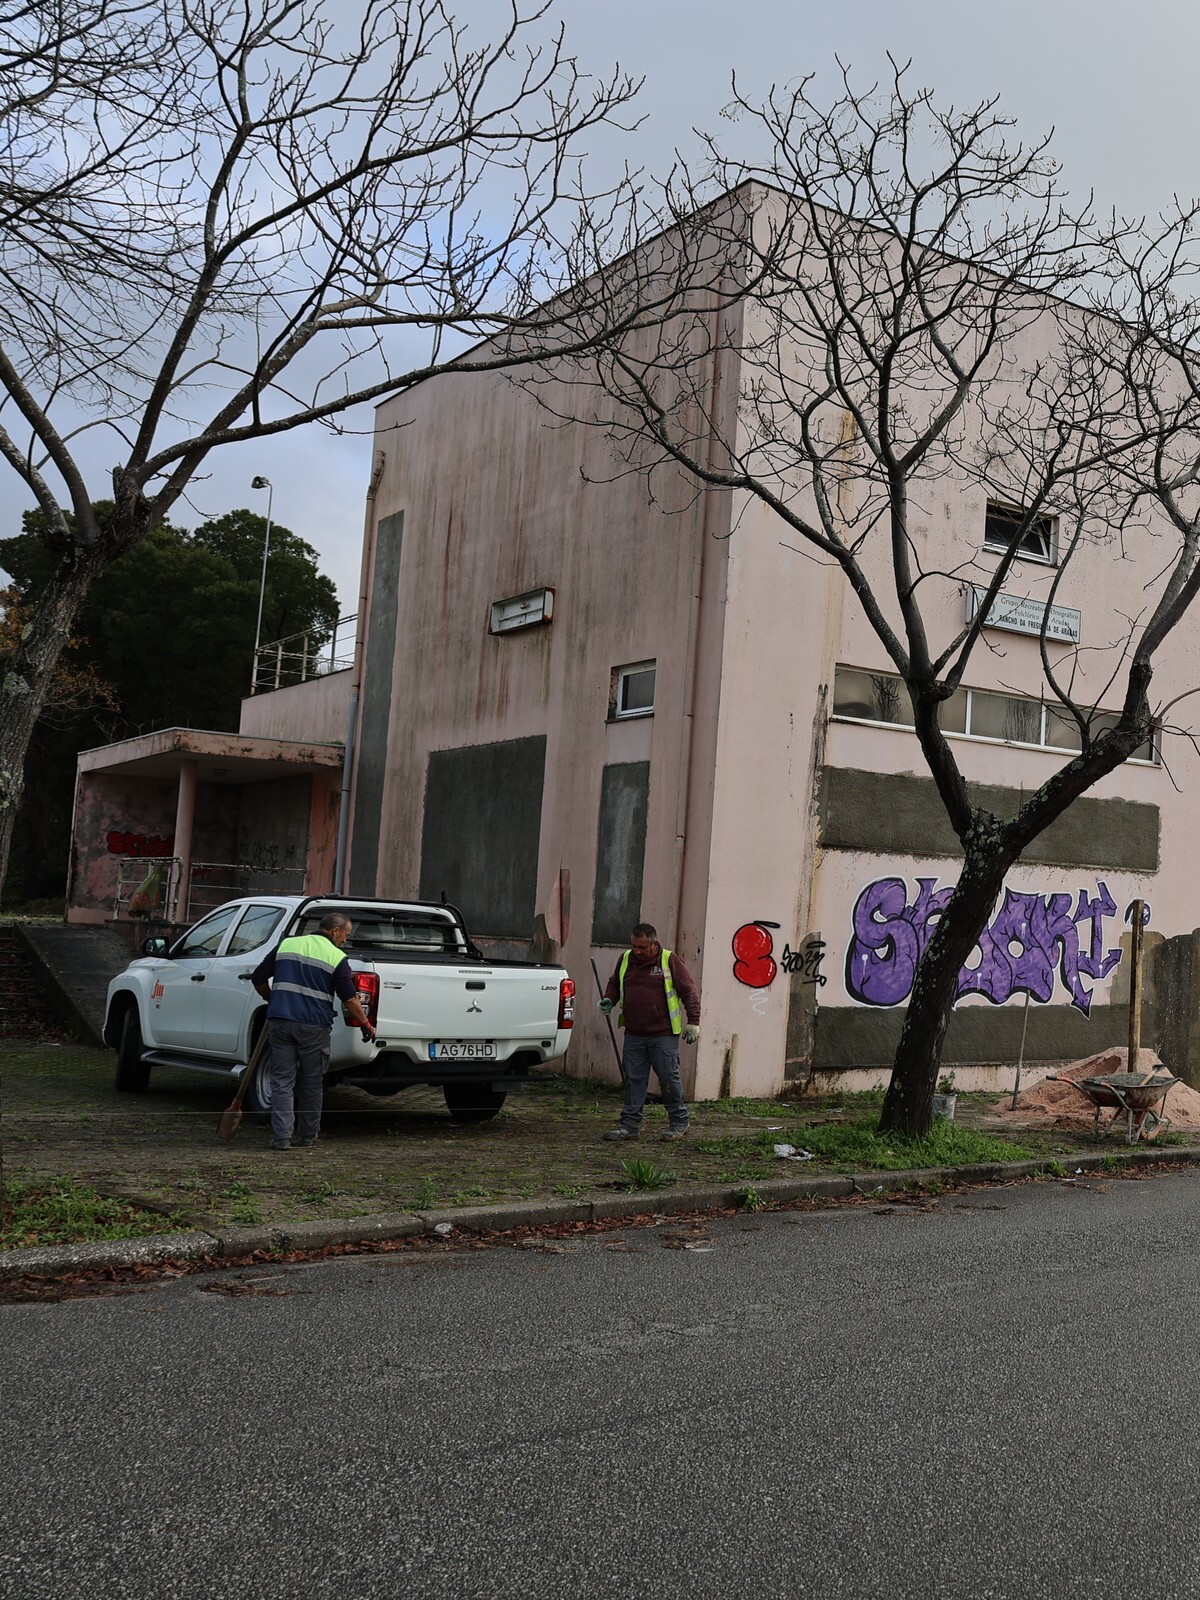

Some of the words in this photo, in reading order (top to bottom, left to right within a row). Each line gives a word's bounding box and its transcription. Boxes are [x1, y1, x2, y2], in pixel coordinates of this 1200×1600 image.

[1001, 597, 1018, 607] Grupo
[1021, 602, 1045, 612] Recreativ
[999, 614, 1018, 625] RANCHO
[1020, 617, 1026, 626] DA
[1028, 620, 1051, 631] FREGUIA
[1053, 625, 1059, 634] DE
